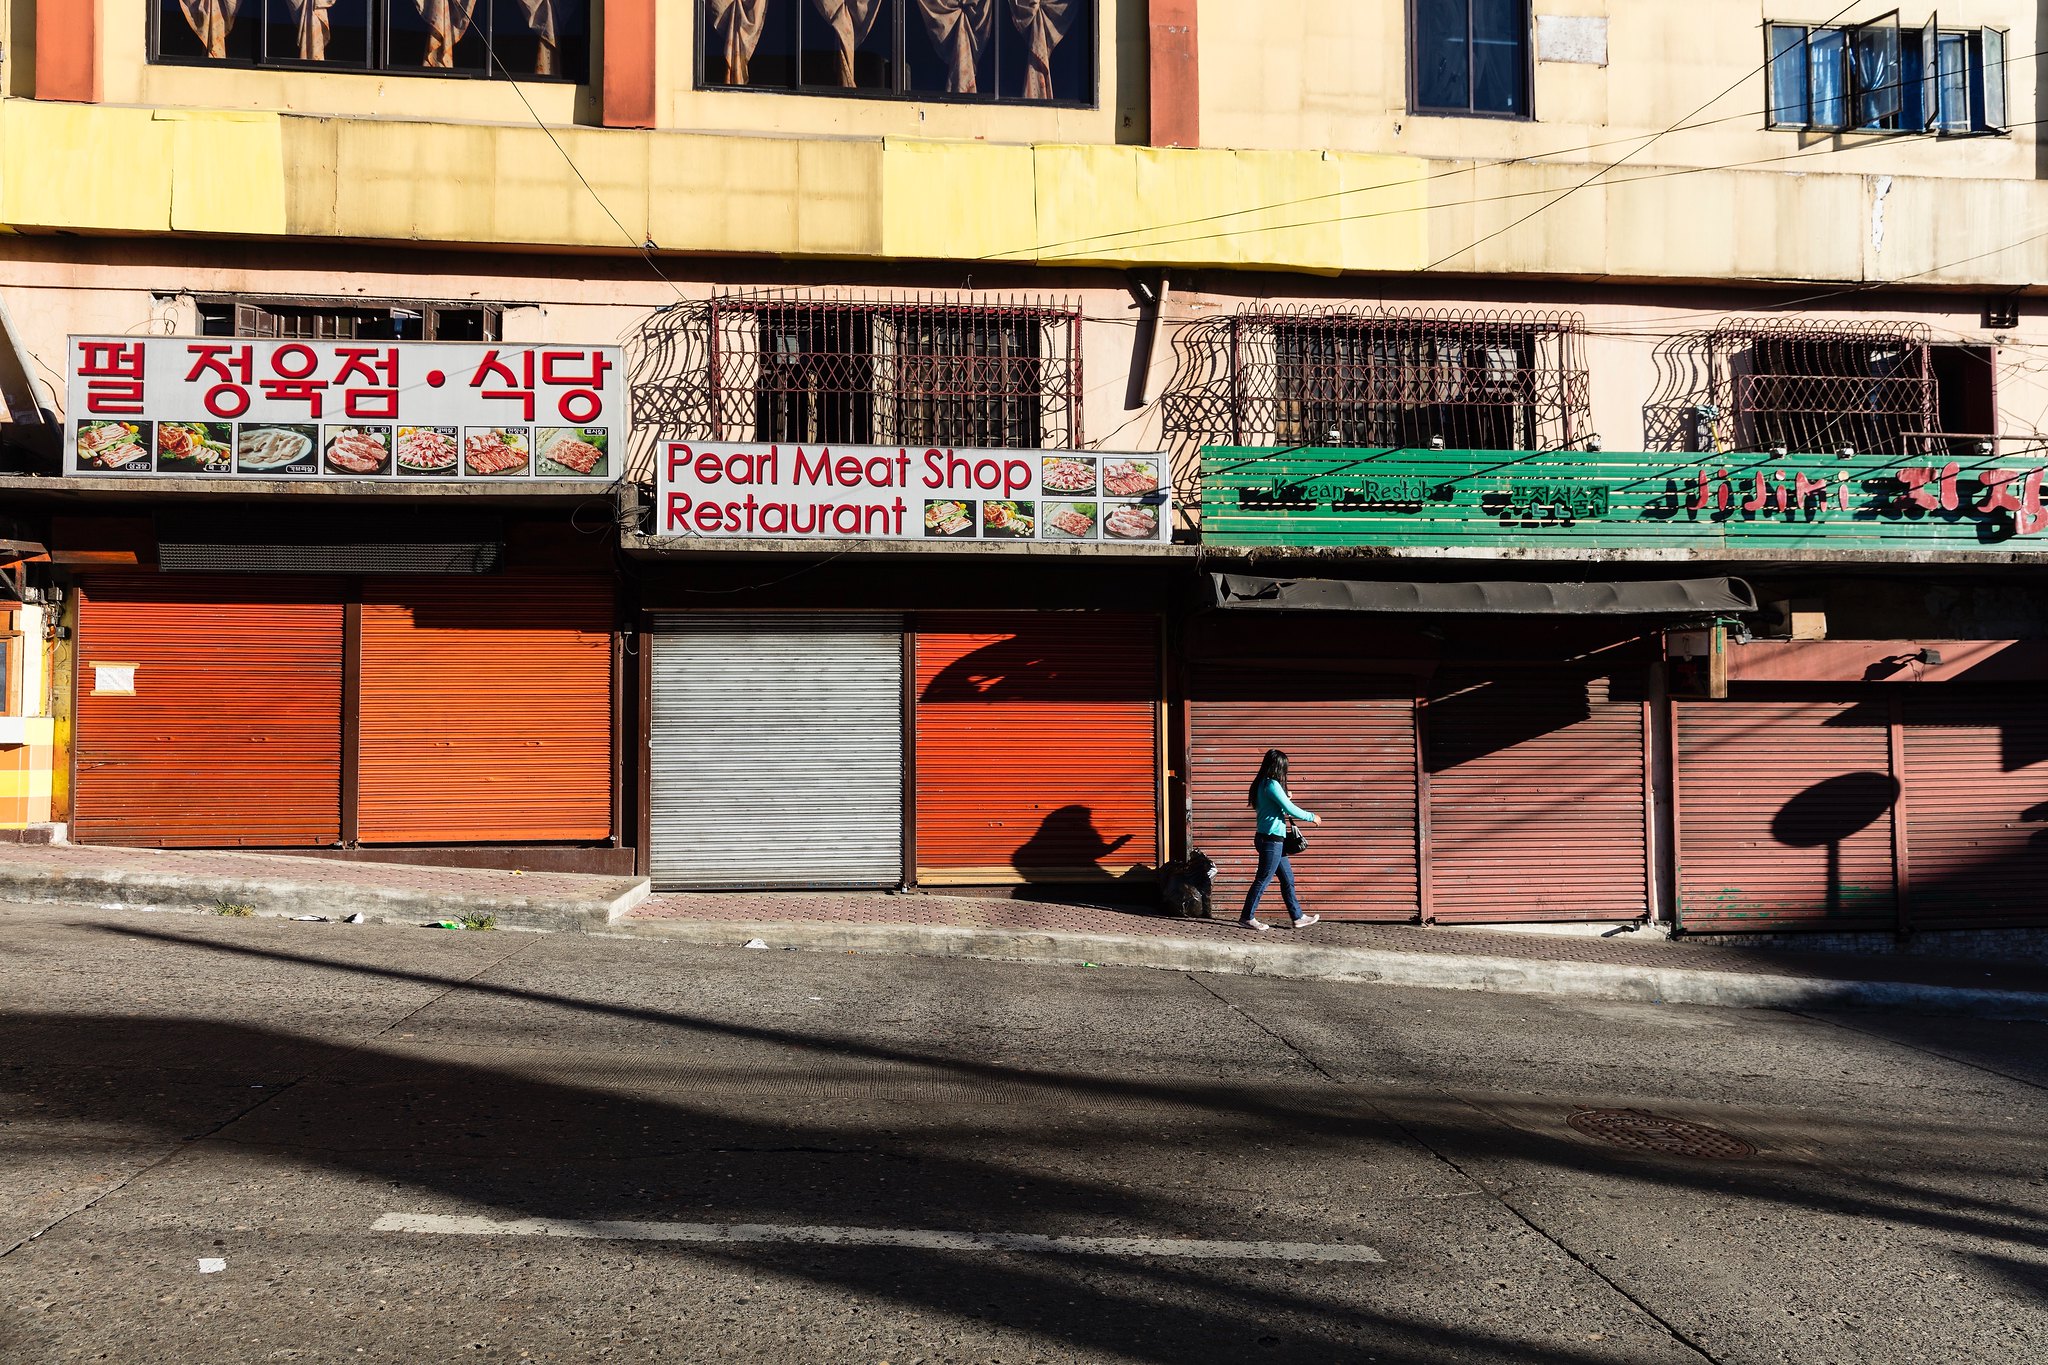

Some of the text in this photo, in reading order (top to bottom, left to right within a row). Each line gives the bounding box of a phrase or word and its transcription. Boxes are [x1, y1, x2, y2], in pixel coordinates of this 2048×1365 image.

[77, 341, 612, 423] 펄 정육점 식당
[667, 443, 1032, 498] Pearl Meat Shop
[1272, 477, 1345, 502] Krean
[667, 491, 908, 534] Restaurant
[1511, 484, 1609, 519] 퓨전선술집
